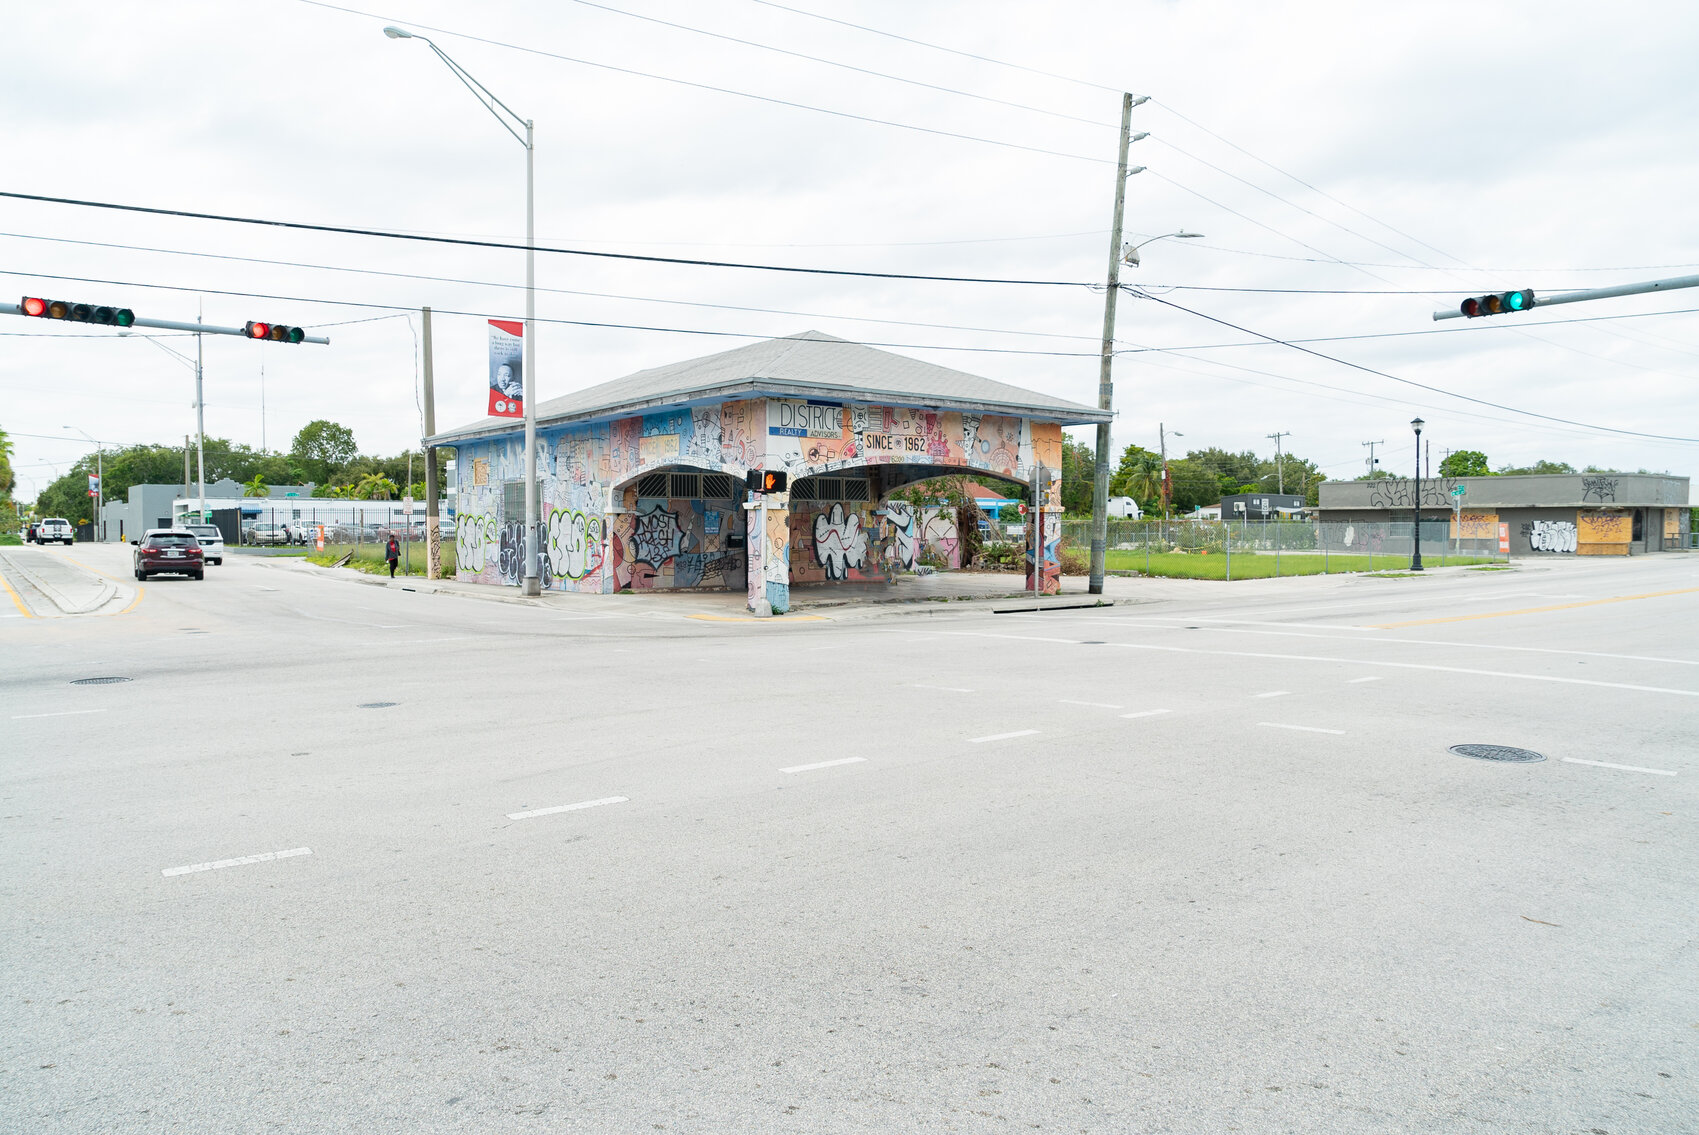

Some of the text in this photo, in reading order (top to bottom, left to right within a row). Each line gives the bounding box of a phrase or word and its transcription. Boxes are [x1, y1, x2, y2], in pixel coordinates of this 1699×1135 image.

[781, 403, 836, 430] DISTRICT
[780, 428, 802, 436] REALTY
[866, 434, 926, 452] SINCE 1962
[640, 514, 675, 529] MOST
